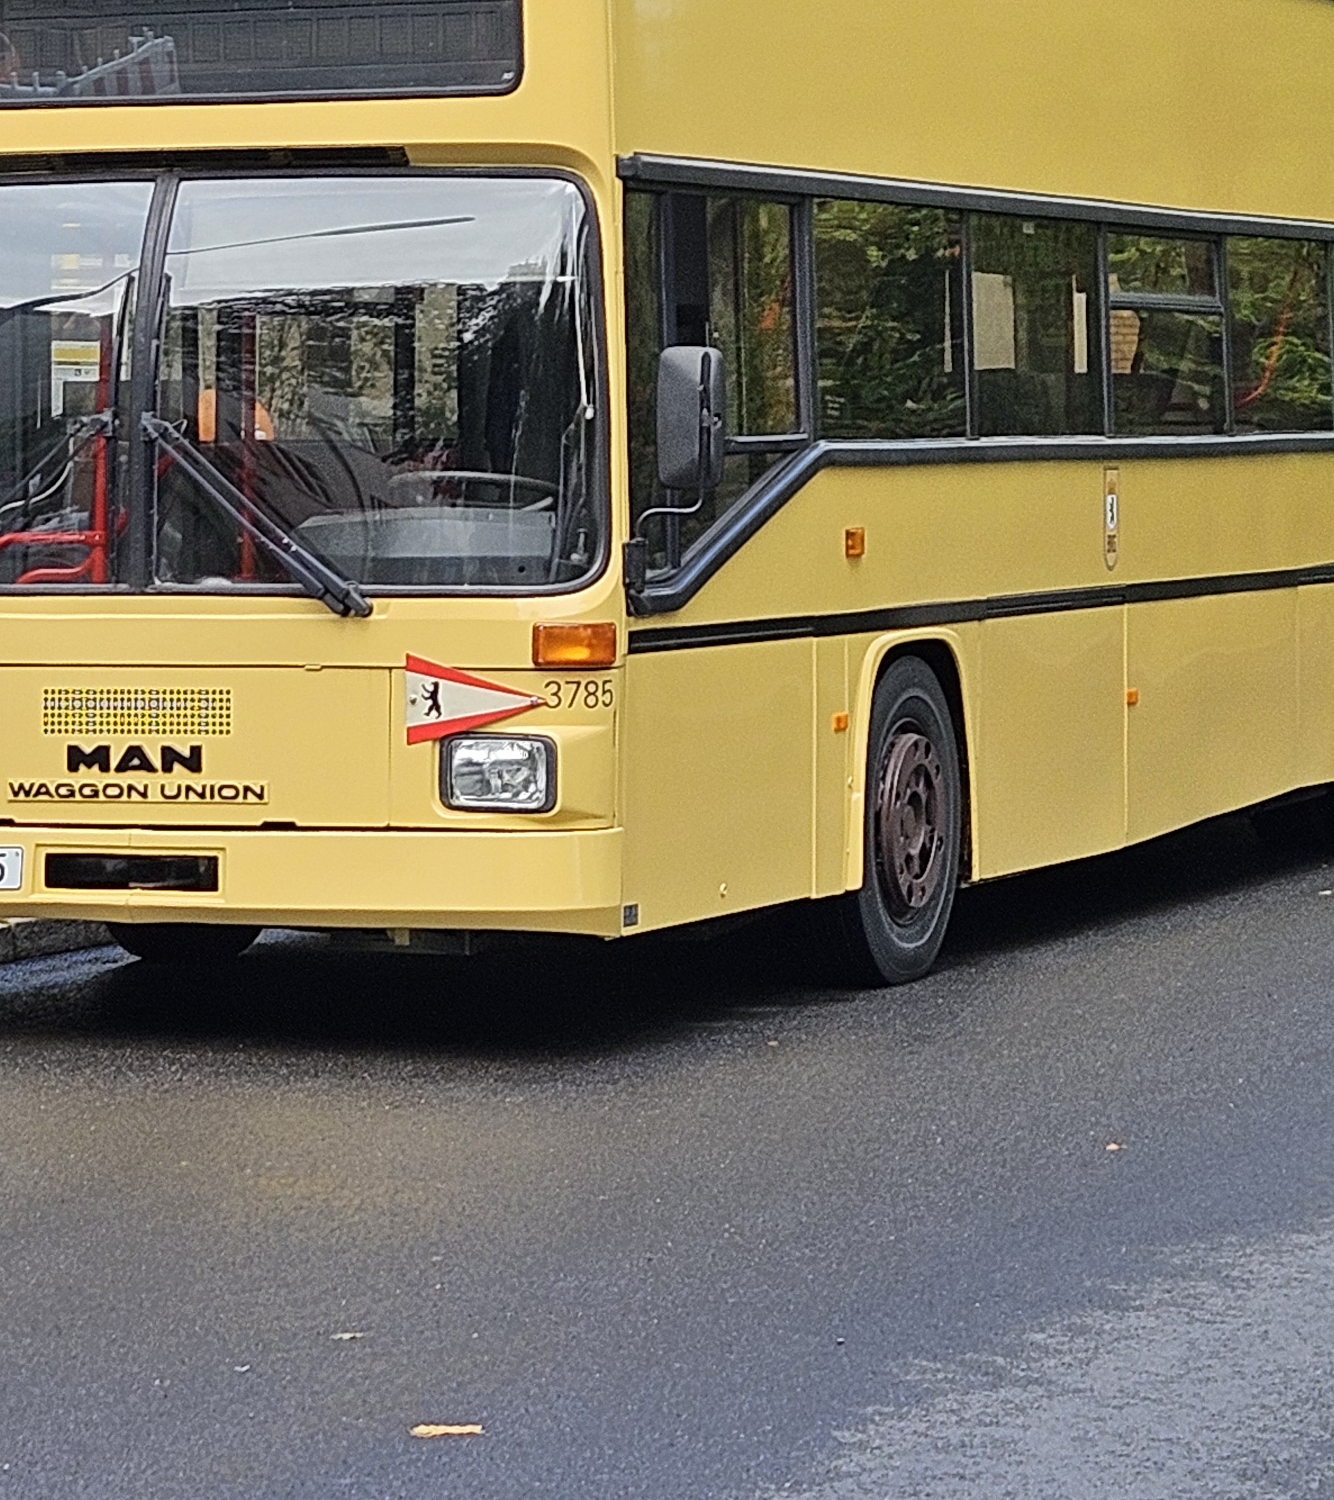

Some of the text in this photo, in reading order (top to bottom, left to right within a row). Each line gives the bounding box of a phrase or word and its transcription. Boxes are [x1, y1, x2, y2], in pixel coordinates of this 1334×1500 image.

[544, 679, 614, 709] 3785
[67, 744, 203, 774] MAN
[8, 781, 266, 801] WAGGON UNION
